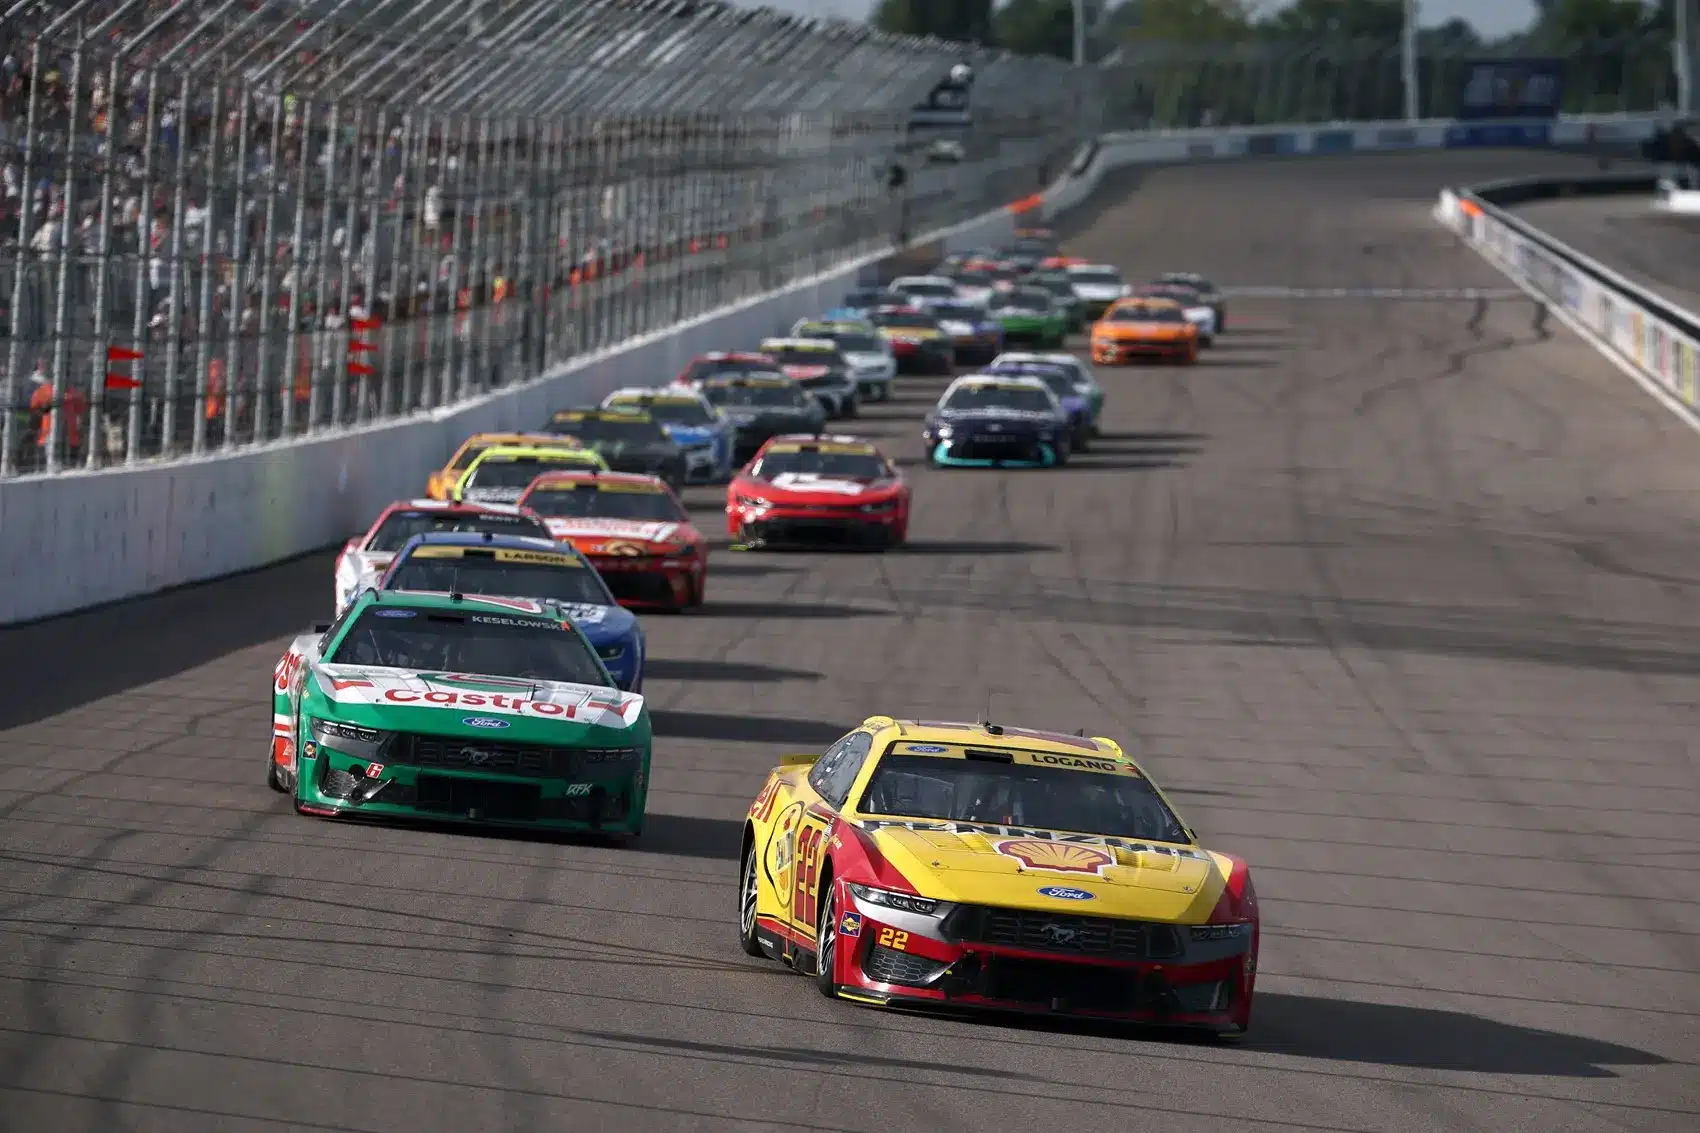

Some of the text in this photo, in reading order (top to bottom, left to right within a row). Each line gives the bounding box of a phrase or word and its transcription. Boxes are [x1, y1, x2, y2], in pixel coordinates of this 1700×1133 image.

[384, 688, 577, 719] Castrol
[472, 718, 501, 727] Ford
[366, 763, 384, 778] 6
[1031, 754, 1116, 771] LOGANO
[565, 784, 592, 796] RFK
[794, 824, 822, 929] 22
[1049, 888, 1084, 899] Ford
[879, 927, 909, 951] 22
